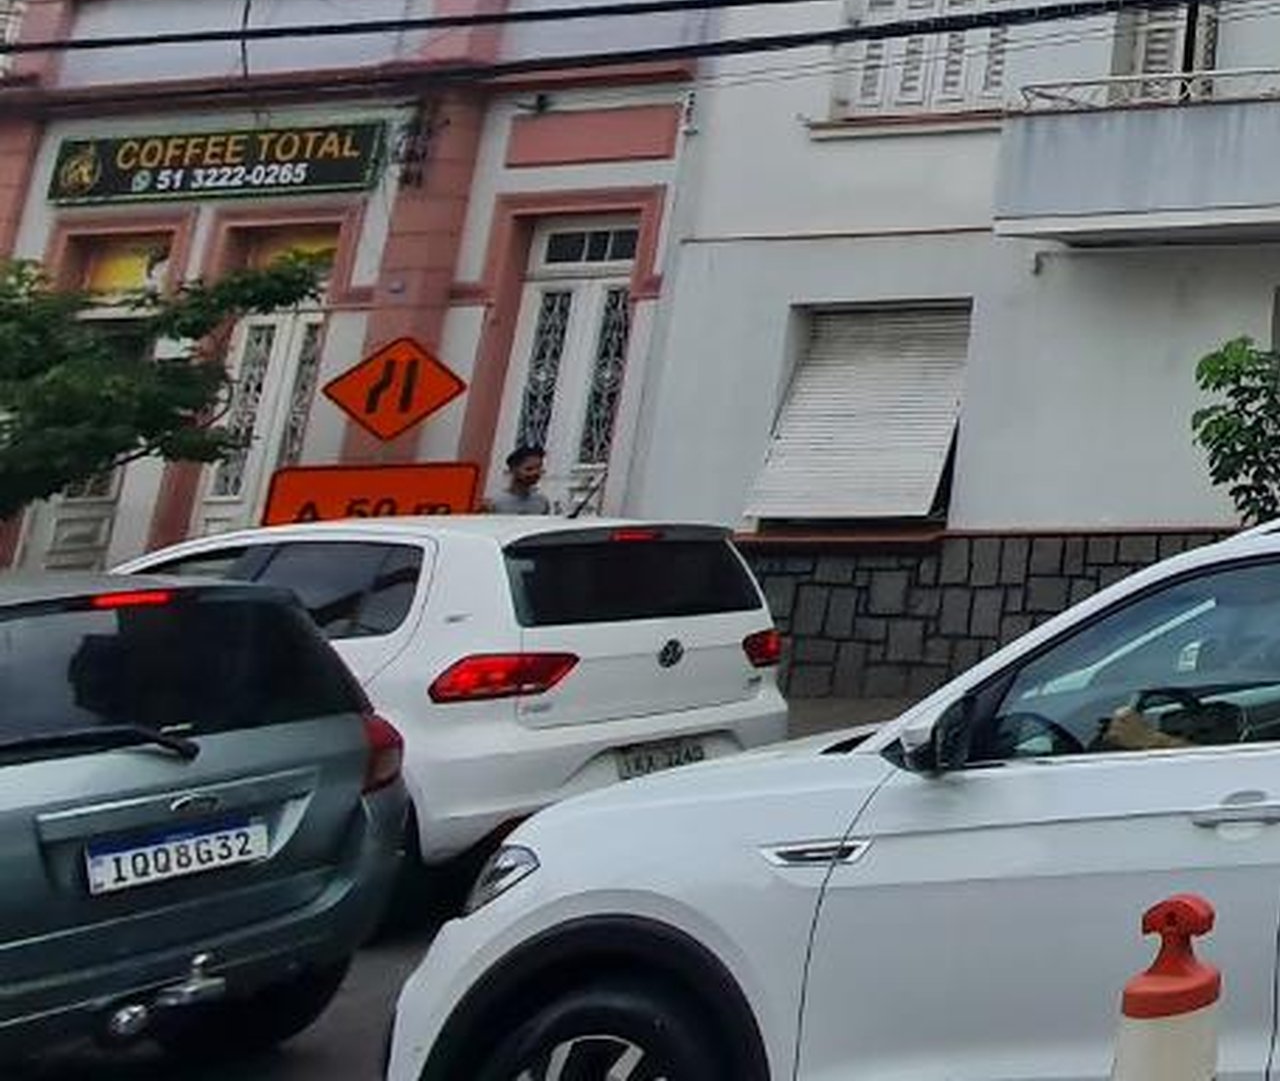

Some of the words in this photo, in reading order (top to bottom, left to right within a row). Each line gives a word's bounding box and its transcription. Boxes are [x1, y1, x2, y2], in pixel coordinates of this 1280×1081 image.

[116, 136, 248, 169] COFFEE
[258, 131, 361, 161] TOTAL
[156, 170, 182, 190] 51
[190, 164, 308, 189] 3222-0265
